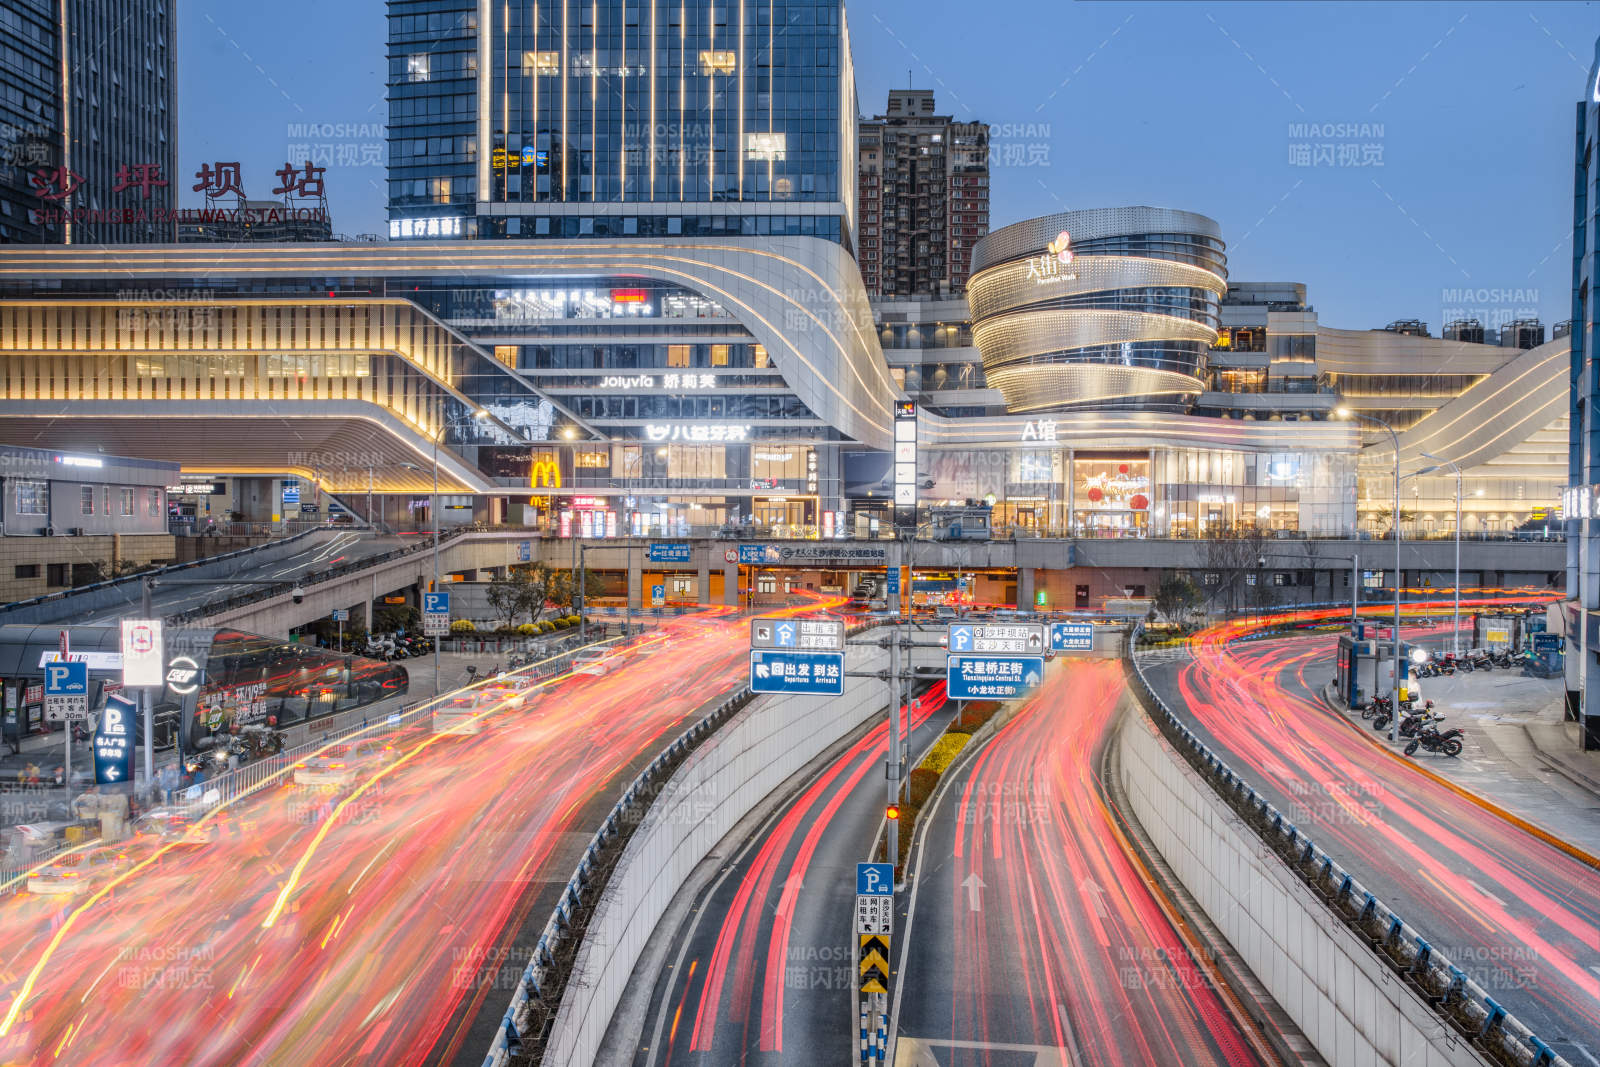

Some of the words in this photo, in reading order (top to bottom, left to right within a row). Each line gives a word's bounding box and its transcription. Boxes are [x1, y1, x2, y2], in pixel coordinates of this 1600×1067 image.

[32, 160, 327, 200] 沙坪坝站
[35, 207, 146, 224] SHAPINGBA
[153, 207, 238, 224] RAILWAY
[246, 207, 327, 224] STATION
[1021, 418, 1057, 441] A馆
[802, 623, 836, 634] 出租车
[985, 627, 1028, 639] 沙坪坝站
[801, 636, 837, 647] 网约车
[975, 640, 1025, 651] 金沙天街
[785, 664, 810, 676] 出发
[813, 664, 840, 677] 到达
[961, 662, 1023, 675] 天星桥正街
[47, 704, 86, 712] 上下客点
[96, 736, 126, 747] 名人广场
[99, 748, 122, 758] 停车场
[859, 898, 868, 923] 出租车
[869, 898, 878, 923] 网约车
